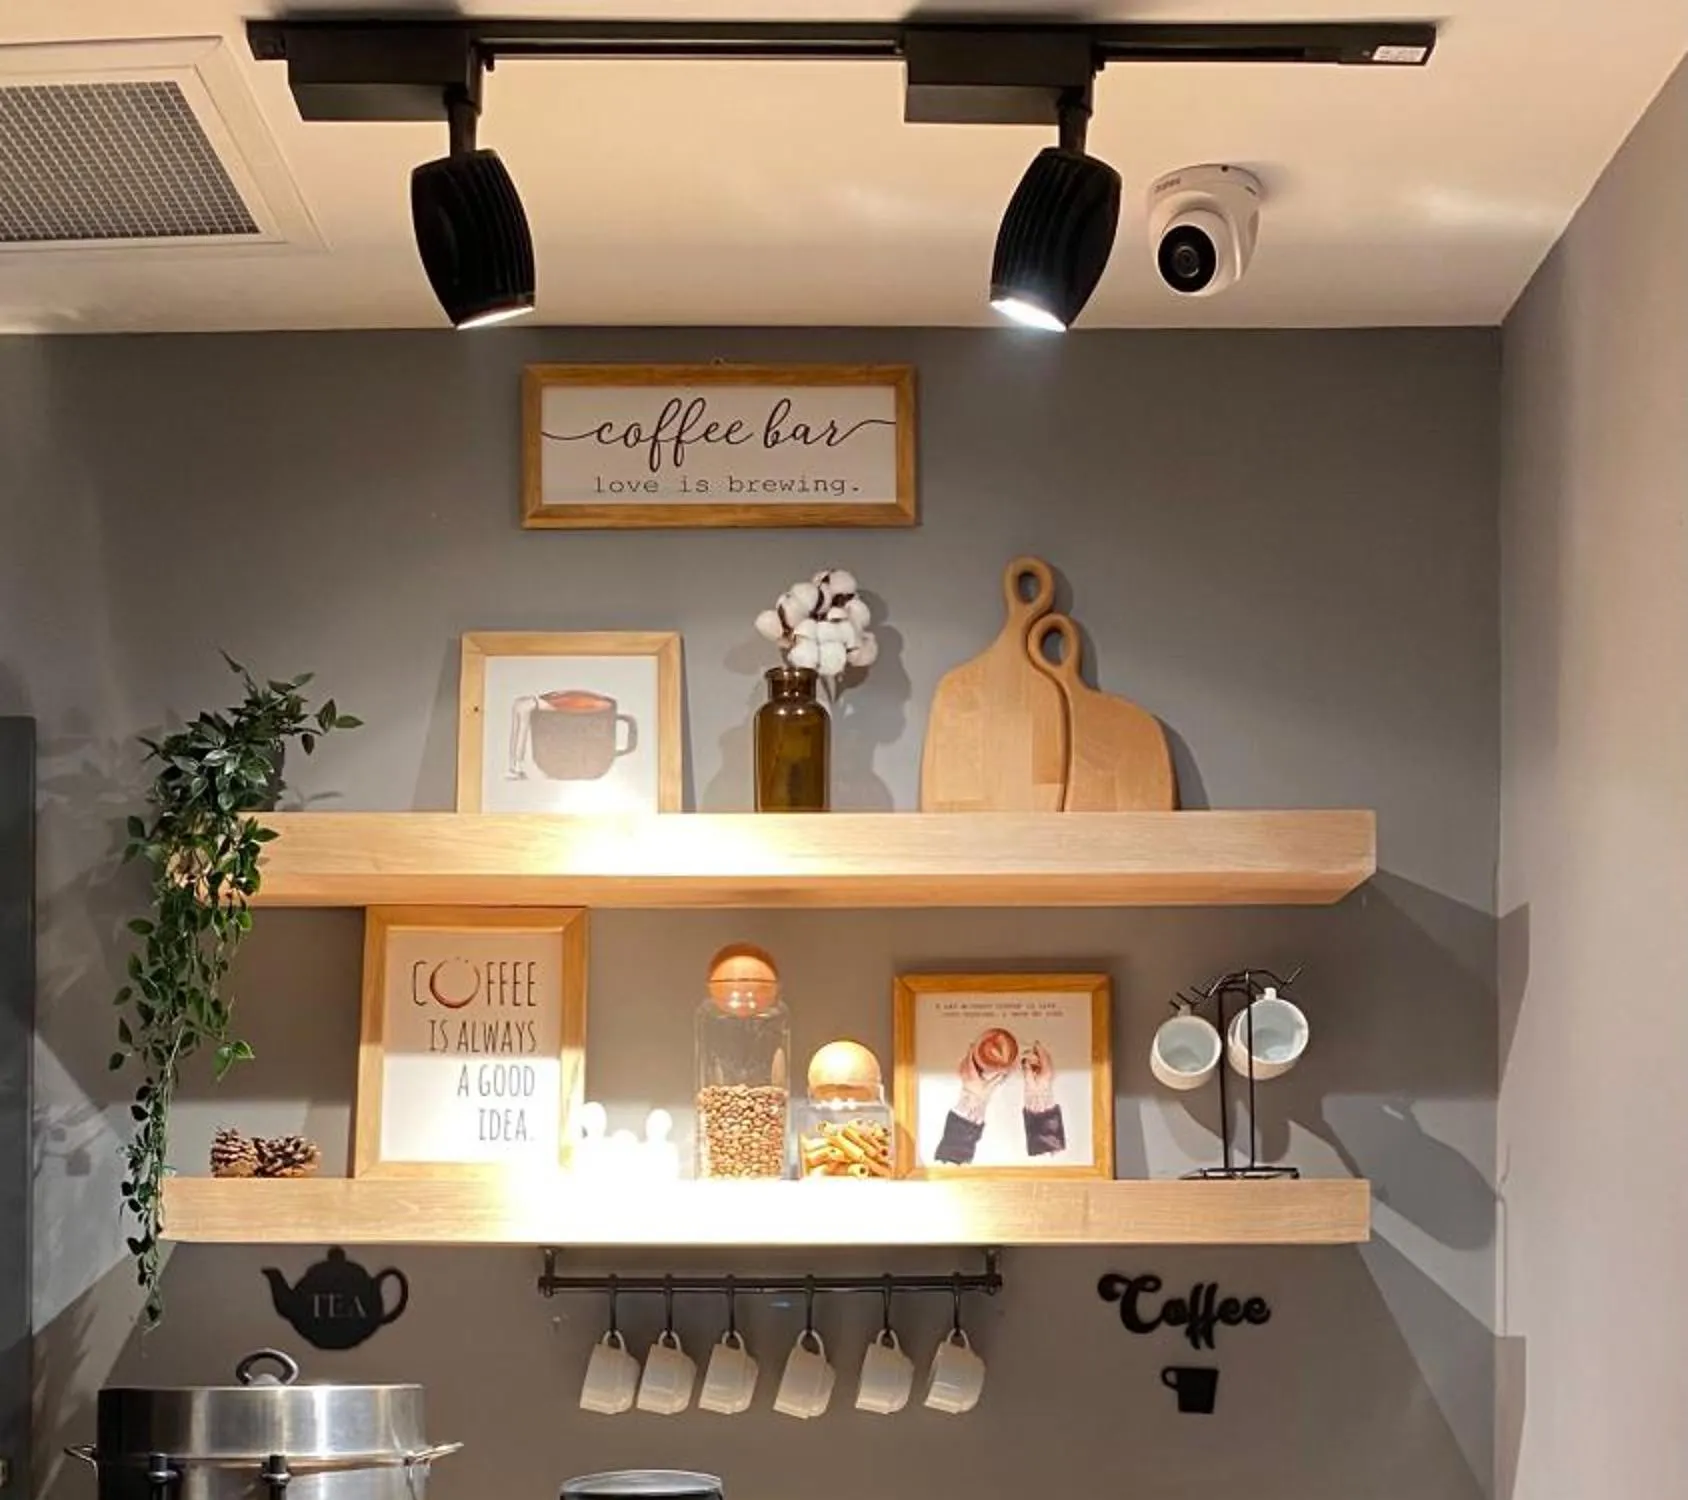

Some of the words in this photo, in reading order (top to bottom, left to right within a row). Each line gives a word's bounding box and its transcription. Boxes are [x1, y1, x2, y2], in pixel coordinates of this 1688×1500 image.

[541, 397, 755, 472] coffee
[763, 398, 896, 449] bar
[594, 475, 659, 494] love
[679, 475, 709, 494] is
[728, 475, 861, 497] brewing.
[411, 957, 537, 1009] COFFEE
[429, 1019, 449, 1052] IS
[457, 1020, 537, 1053] ALWAYS
[457, 1064, 469, 1097] A
[478, 1064, 535, 1097] GOOD
[312, 1293, 367, 1319] TEA
[1097, 1273, 1271, 1350] Coffee
